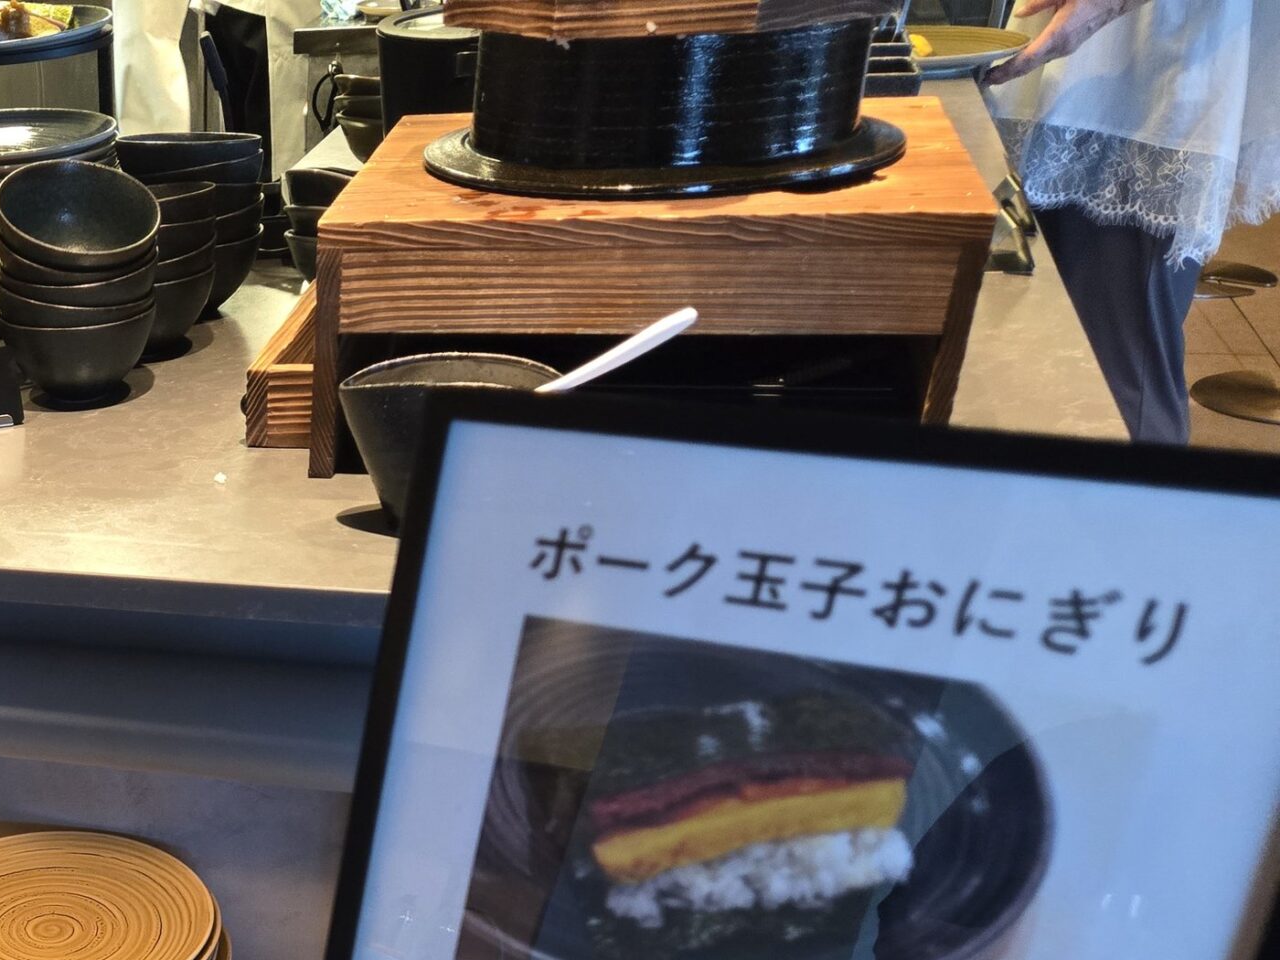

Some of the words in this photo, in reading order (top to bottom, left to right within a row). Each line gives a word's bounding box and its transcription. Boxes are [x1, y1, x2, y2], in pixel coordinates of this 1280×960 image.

[528, 523, 1190, 666] ポーク玉子おにぎり
